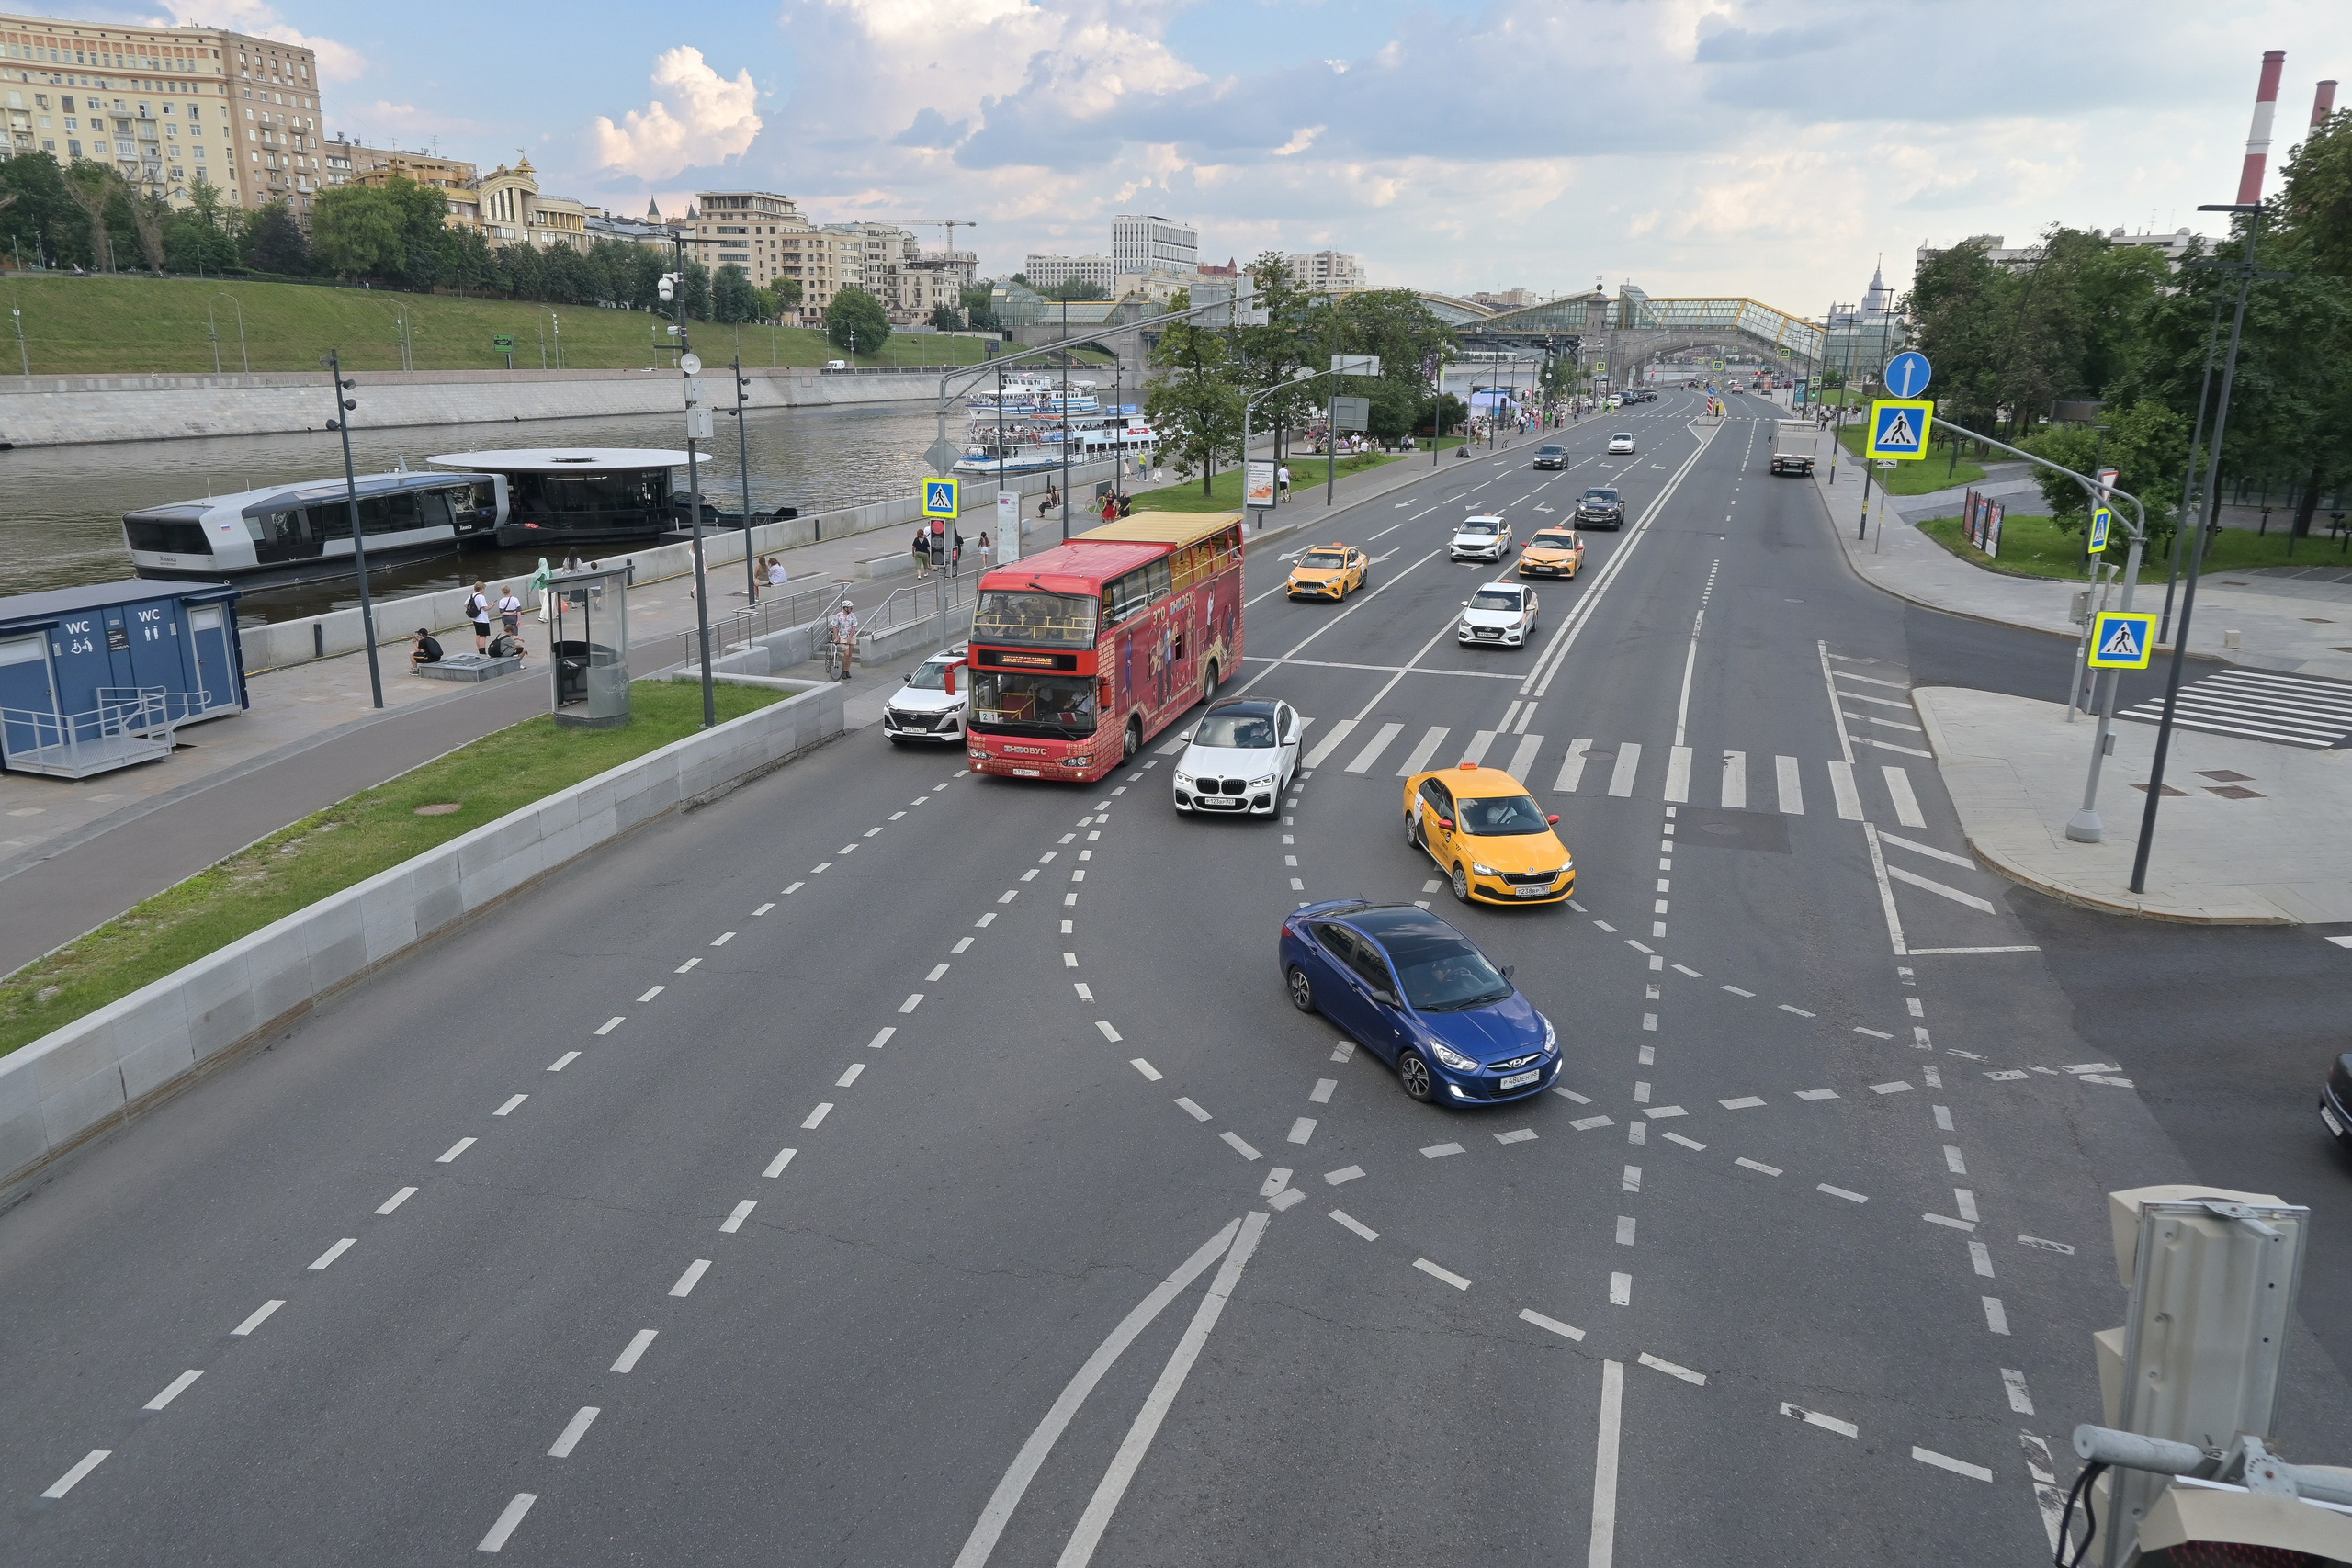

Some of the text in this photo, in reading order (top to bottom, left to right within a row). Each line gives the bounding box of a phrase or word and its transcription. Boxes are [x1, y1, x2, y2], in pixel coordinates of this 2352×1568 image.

[138, 608, 161, 623] WC
[1153, 606, 1166, 626] ЭТО
[65, 620, 90, 635] WC
